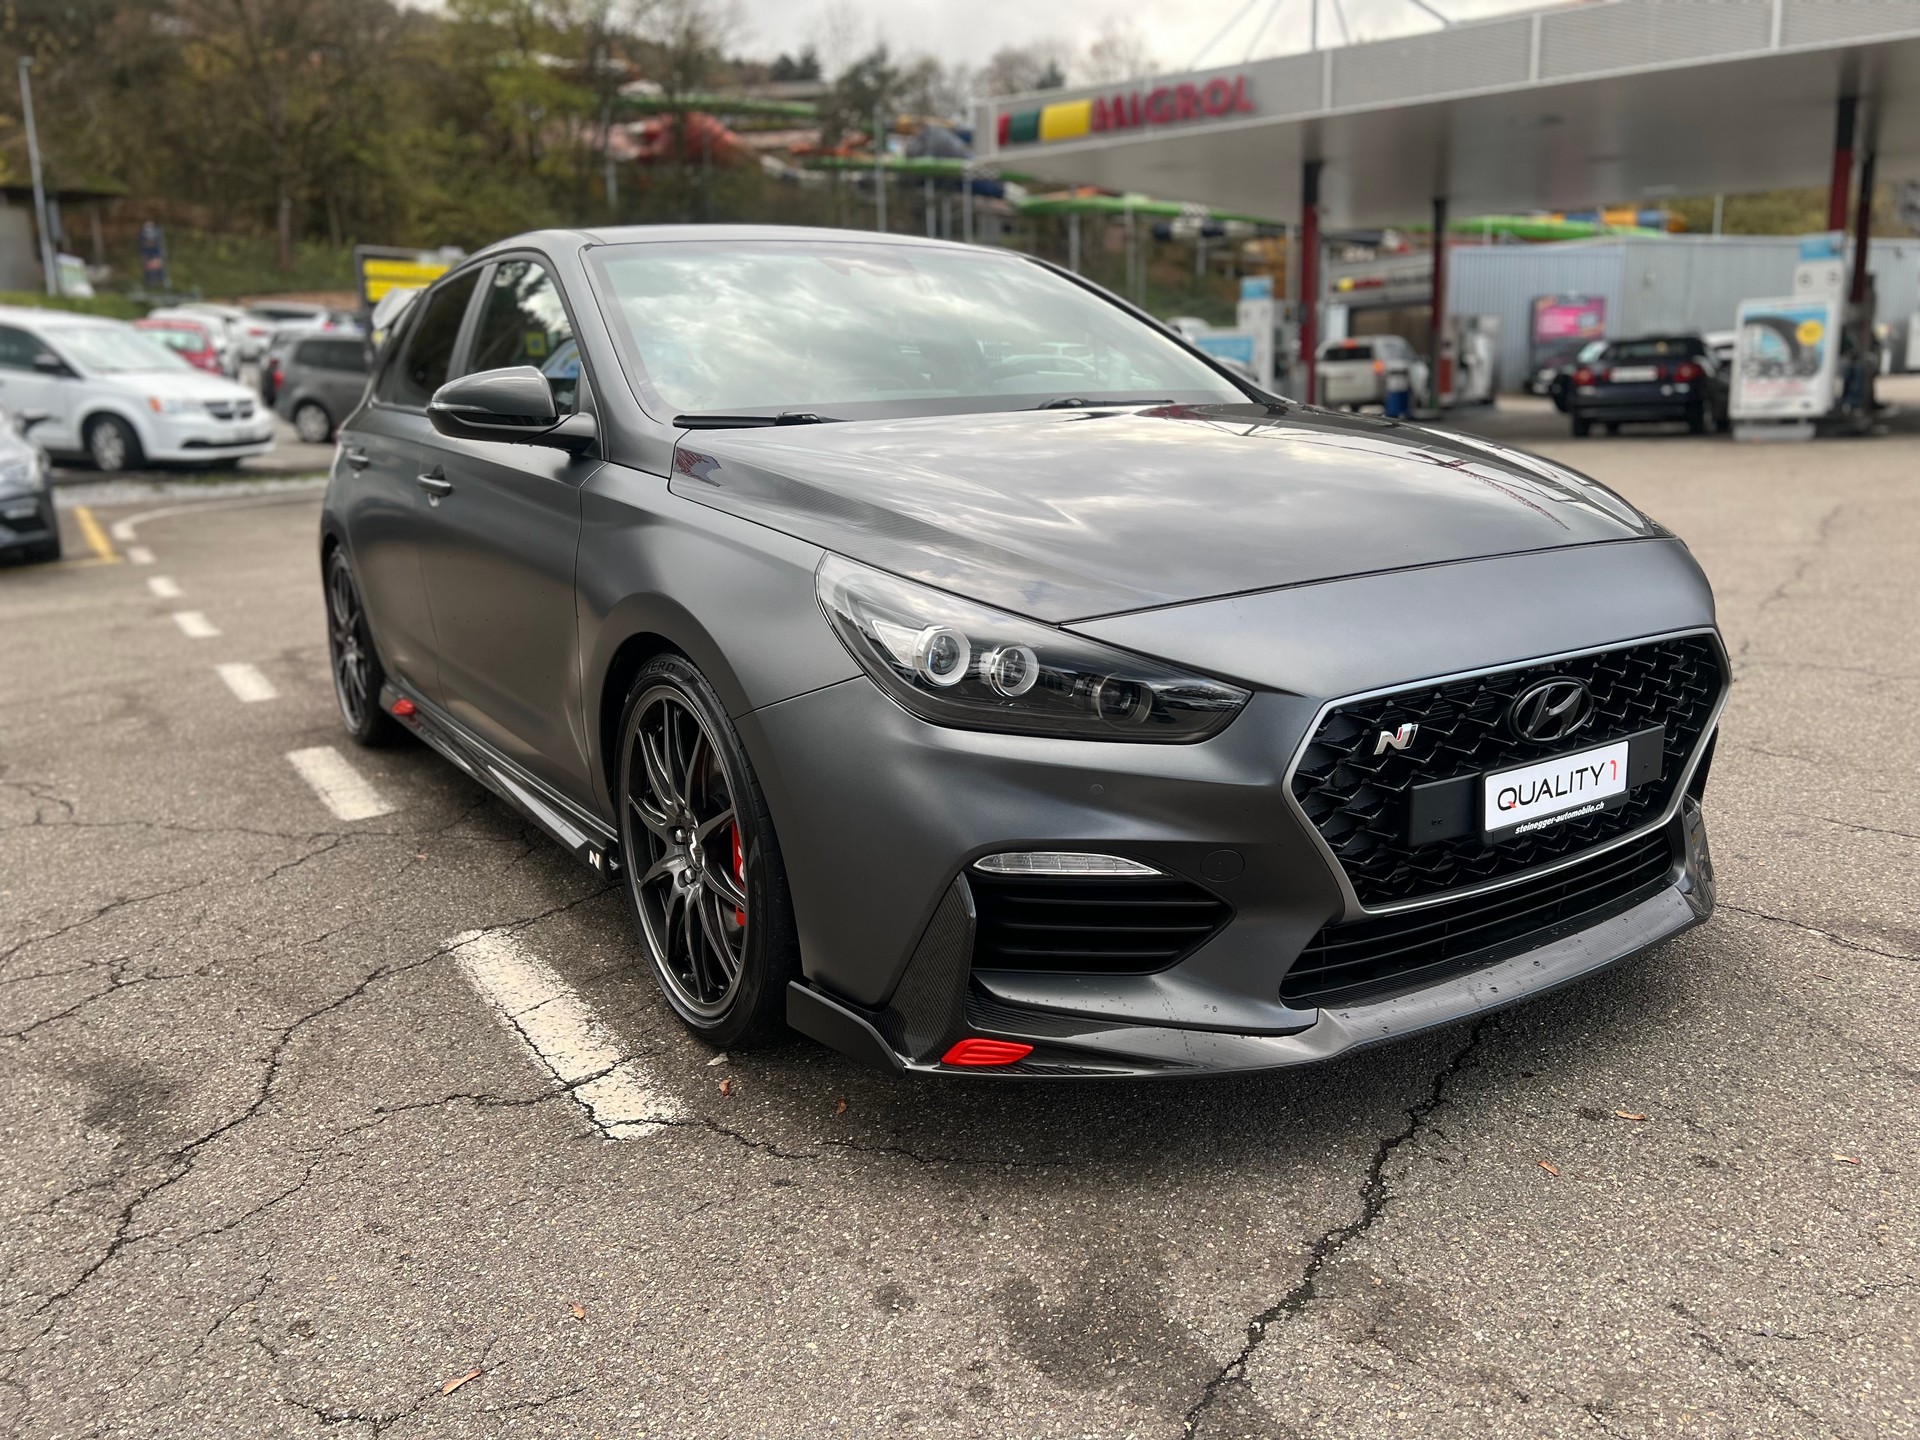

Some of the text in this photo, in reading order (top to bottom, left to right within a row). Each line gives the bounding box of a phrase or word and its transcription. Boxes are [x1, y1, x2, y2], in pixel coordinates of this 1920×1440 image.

[1092, 75, 1255, 132] MIGROL
[1373, 722, 1418, 755] N
[1514, 801, 1605, 834] steinegger-automobile.ch
[589, 849, 600, 870] N
